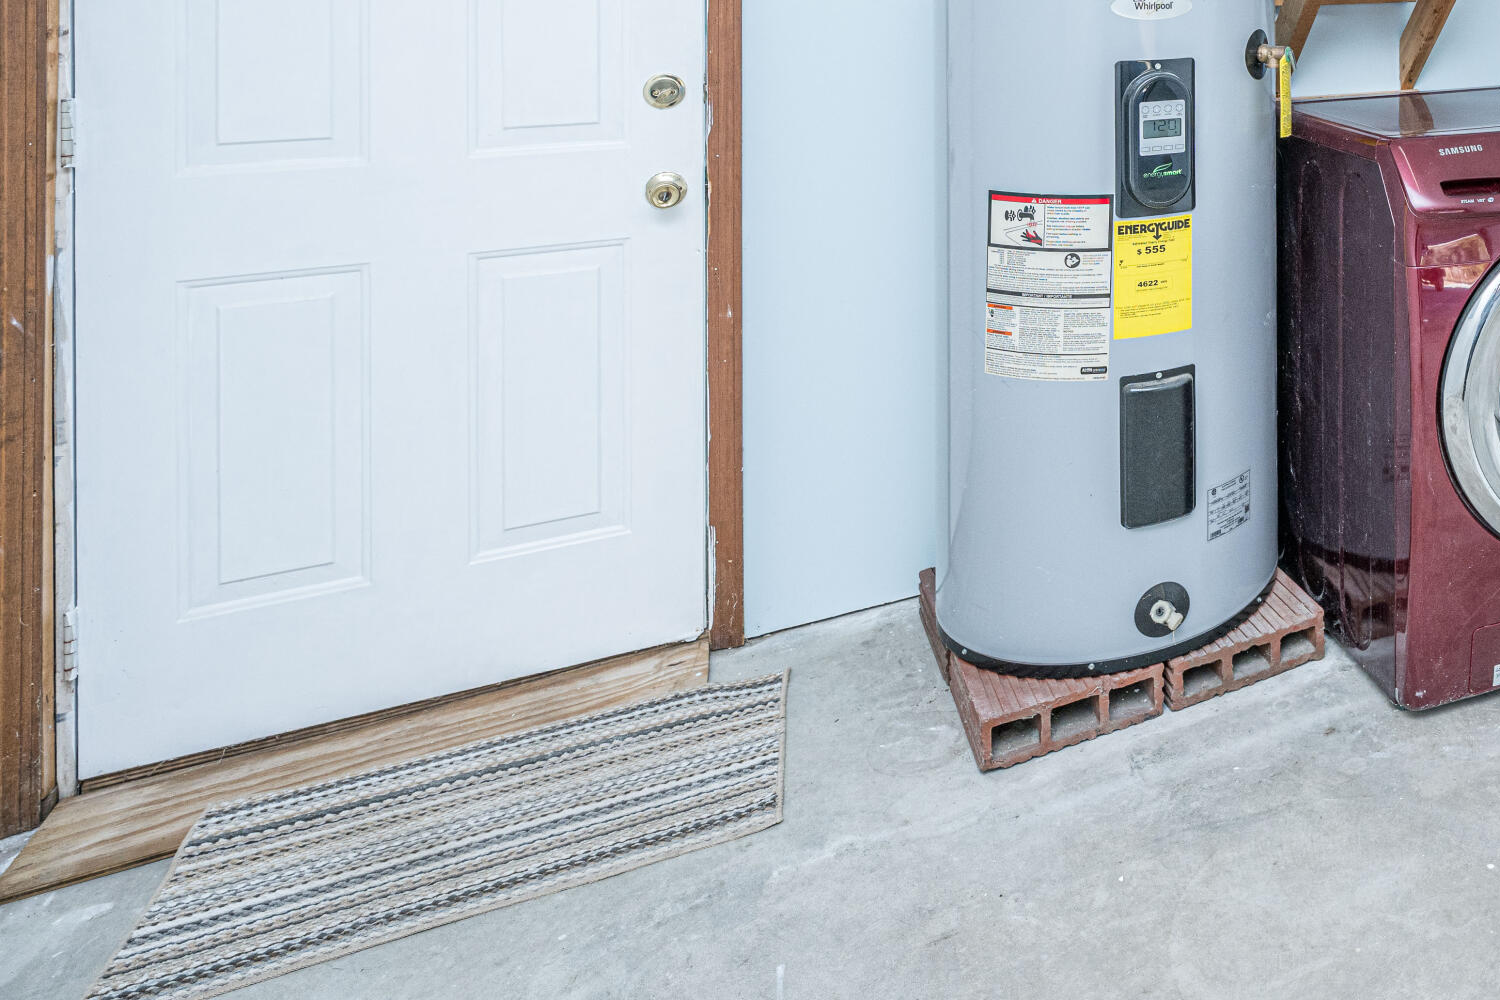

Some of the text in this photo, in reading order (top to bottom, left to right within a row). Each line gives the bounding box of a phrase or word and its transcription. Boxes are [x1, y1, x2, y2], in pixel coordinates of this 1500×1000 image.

[1134, 1, 1173, 11] Whirlpool
[1153, 119, 1177, 132] 120
[1439, 144, 1483, 156] SAMSUNG
[1117, 218, 1190, 237] ENERGYGUIDE
[1145, 245, 1166, 254] 555
